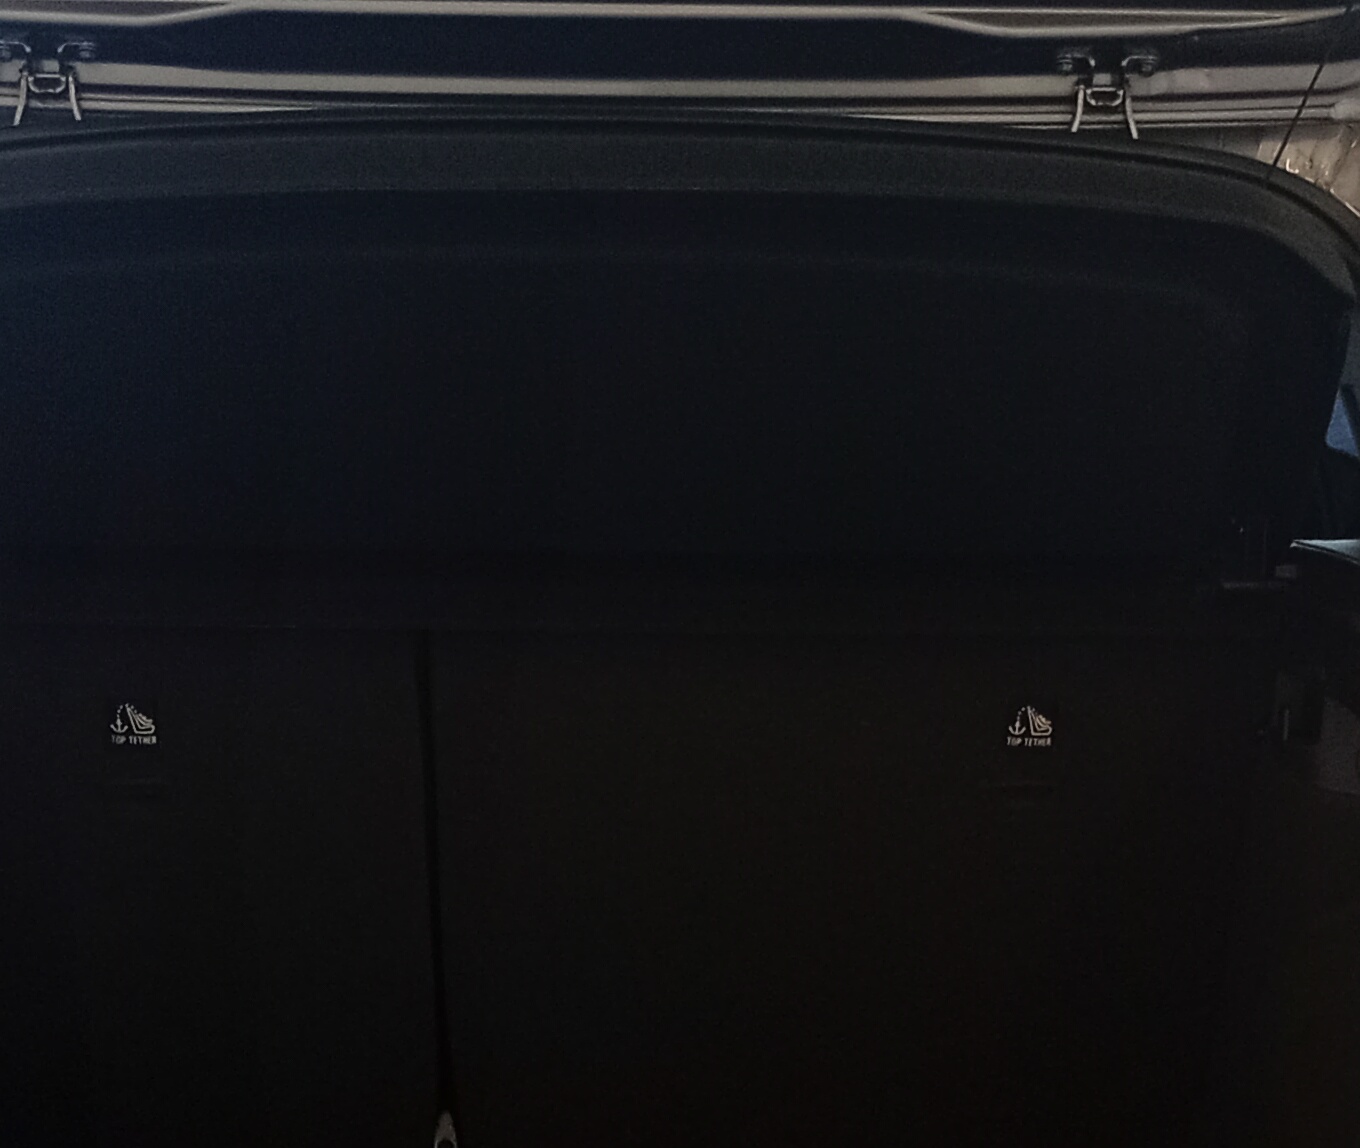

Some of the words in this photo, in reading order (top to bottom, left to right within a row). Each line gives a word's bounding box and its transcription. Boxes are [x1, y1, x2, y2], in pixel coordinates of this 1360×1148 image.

[111, 734, 127, 745] TOP
[128, 735, 158, 745] TETHER
[1006, 736, 1022, 747] TOP
[1024, 737, 1052, 747] TETHER
